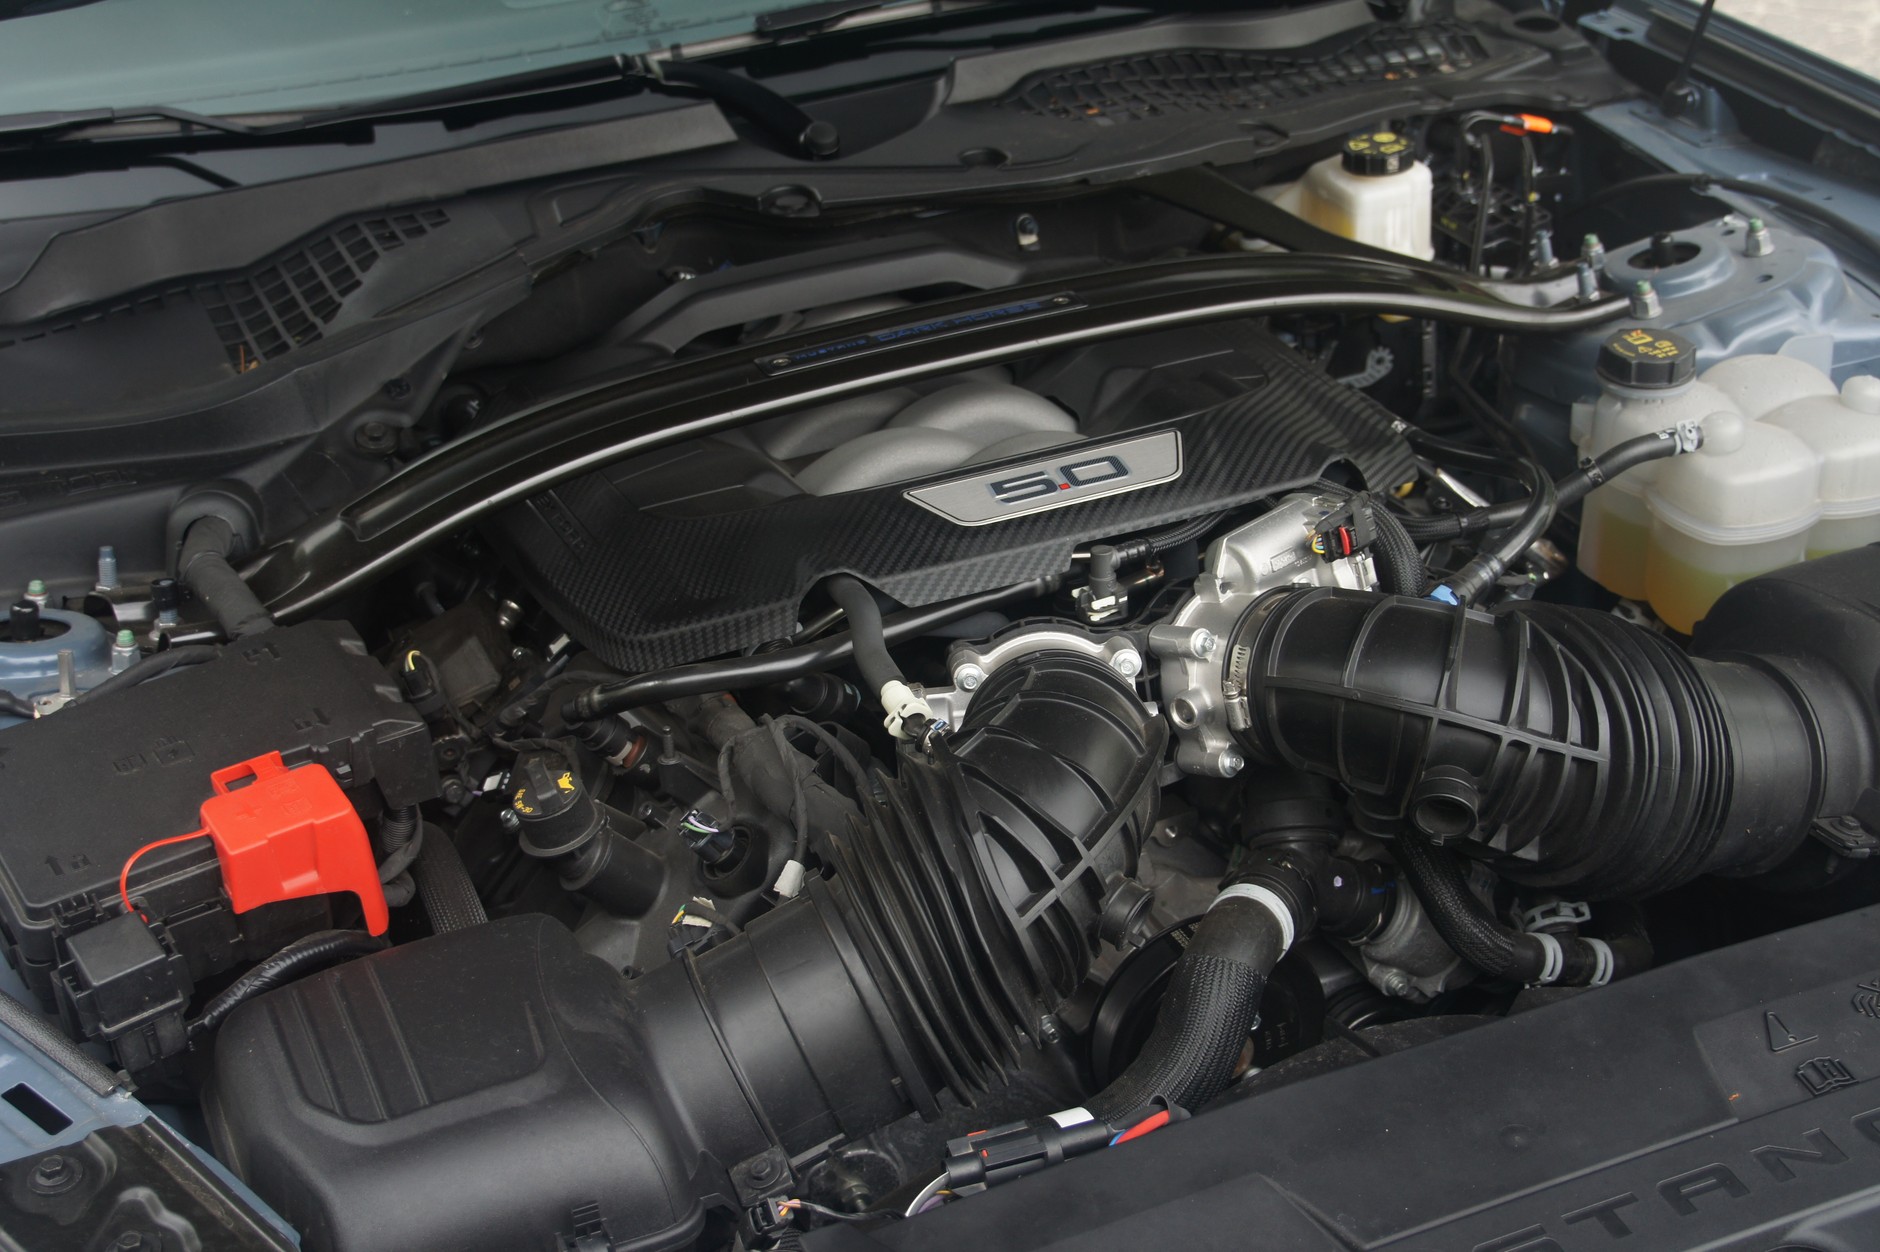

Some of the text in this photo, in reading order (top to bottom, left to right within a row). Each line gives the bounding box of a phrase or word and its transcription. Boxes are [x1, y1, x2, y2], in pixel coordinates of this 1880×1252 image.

[876, 321, 945, 342] DARK
[951, 302, 1043, 326] HORSE
[986, 455, 1131, 506] 5.0
